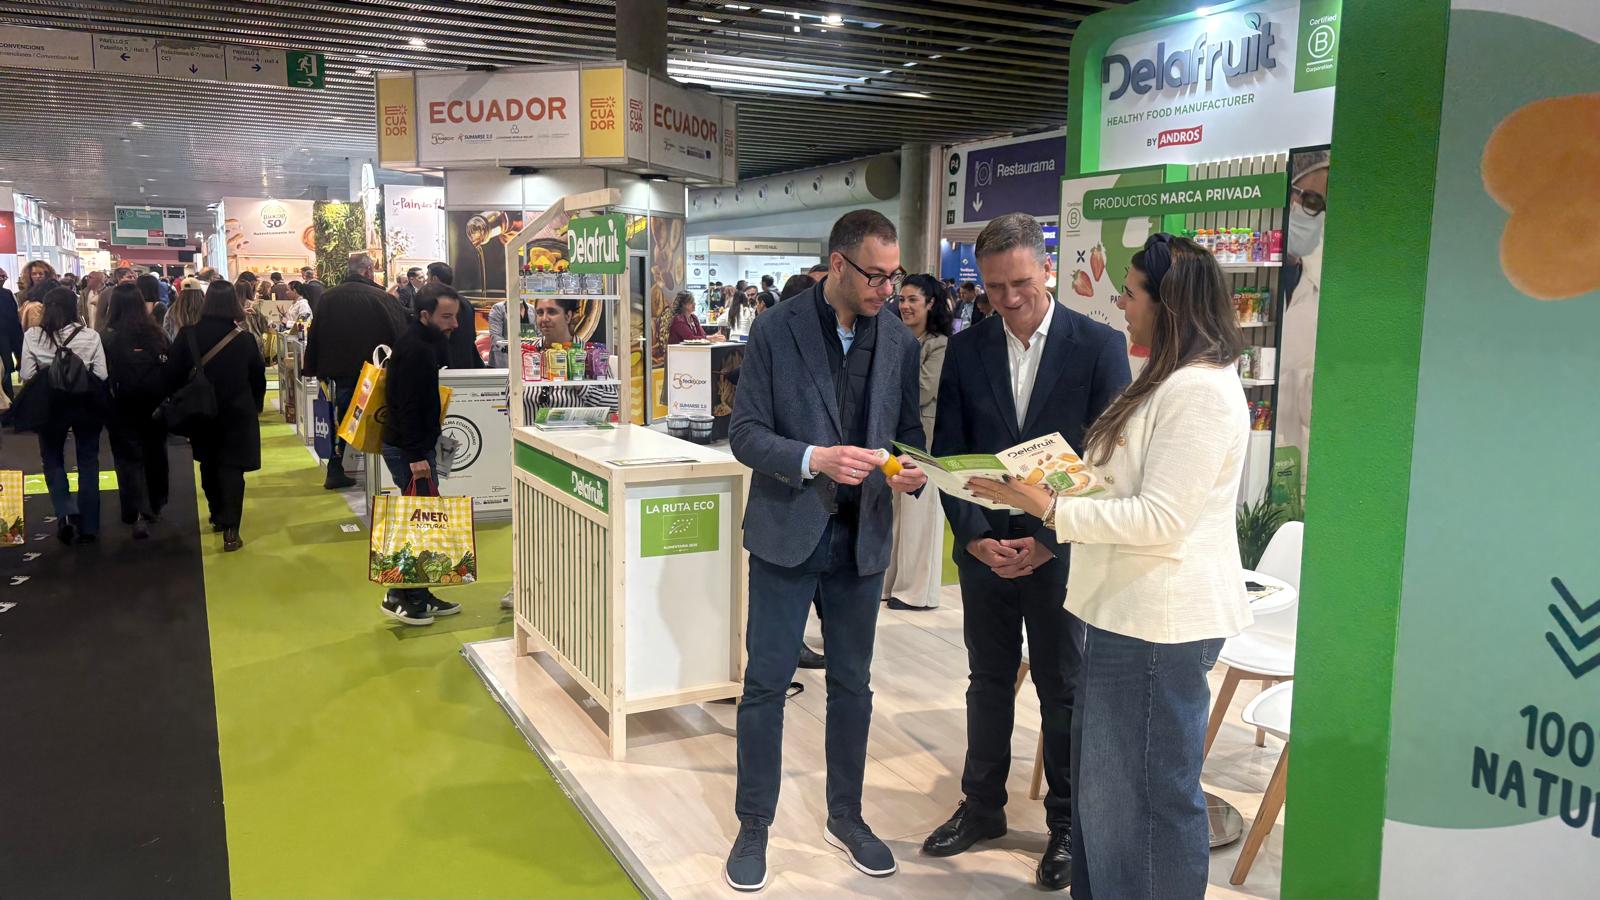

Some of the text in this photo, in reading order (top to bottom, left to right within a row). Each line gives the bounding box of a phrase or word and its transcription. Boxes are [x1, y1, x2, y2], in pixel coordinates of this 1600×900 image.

[1310, 15, 1337, 26] Certified
[1102, 16, 1277, 101] Delafruit
[429, 97, 567, 124] ECUADOR
[591, 109, 615, 119] CUA
[1107, 93, 1255, 127] HEALTHY FOOD MANUFACTURER
[385, 116, 407, 126] CUA
[591, 120, 615, 130] DOR
[654, 103, 717, 144] ECUADOR
[386, 127, 408, 137] DOR
[1146, 129, 1201, 148] BY ANDROS
[997, 159, 1056, 177] Restaurama
[401, 197, 421, 210] Pain
[1093, 184, 1263, 210] PRODUCTOS MARCA PRIVADA
[568, 218, 620, 264] Delafruit
[1007, 438, 1056, 459] Delafruit
[571, 470, 604, 508] Delafruit
[646, 501, 714, 514] LA RUTA ECO
[1519, 704, 1595, 768] 100
